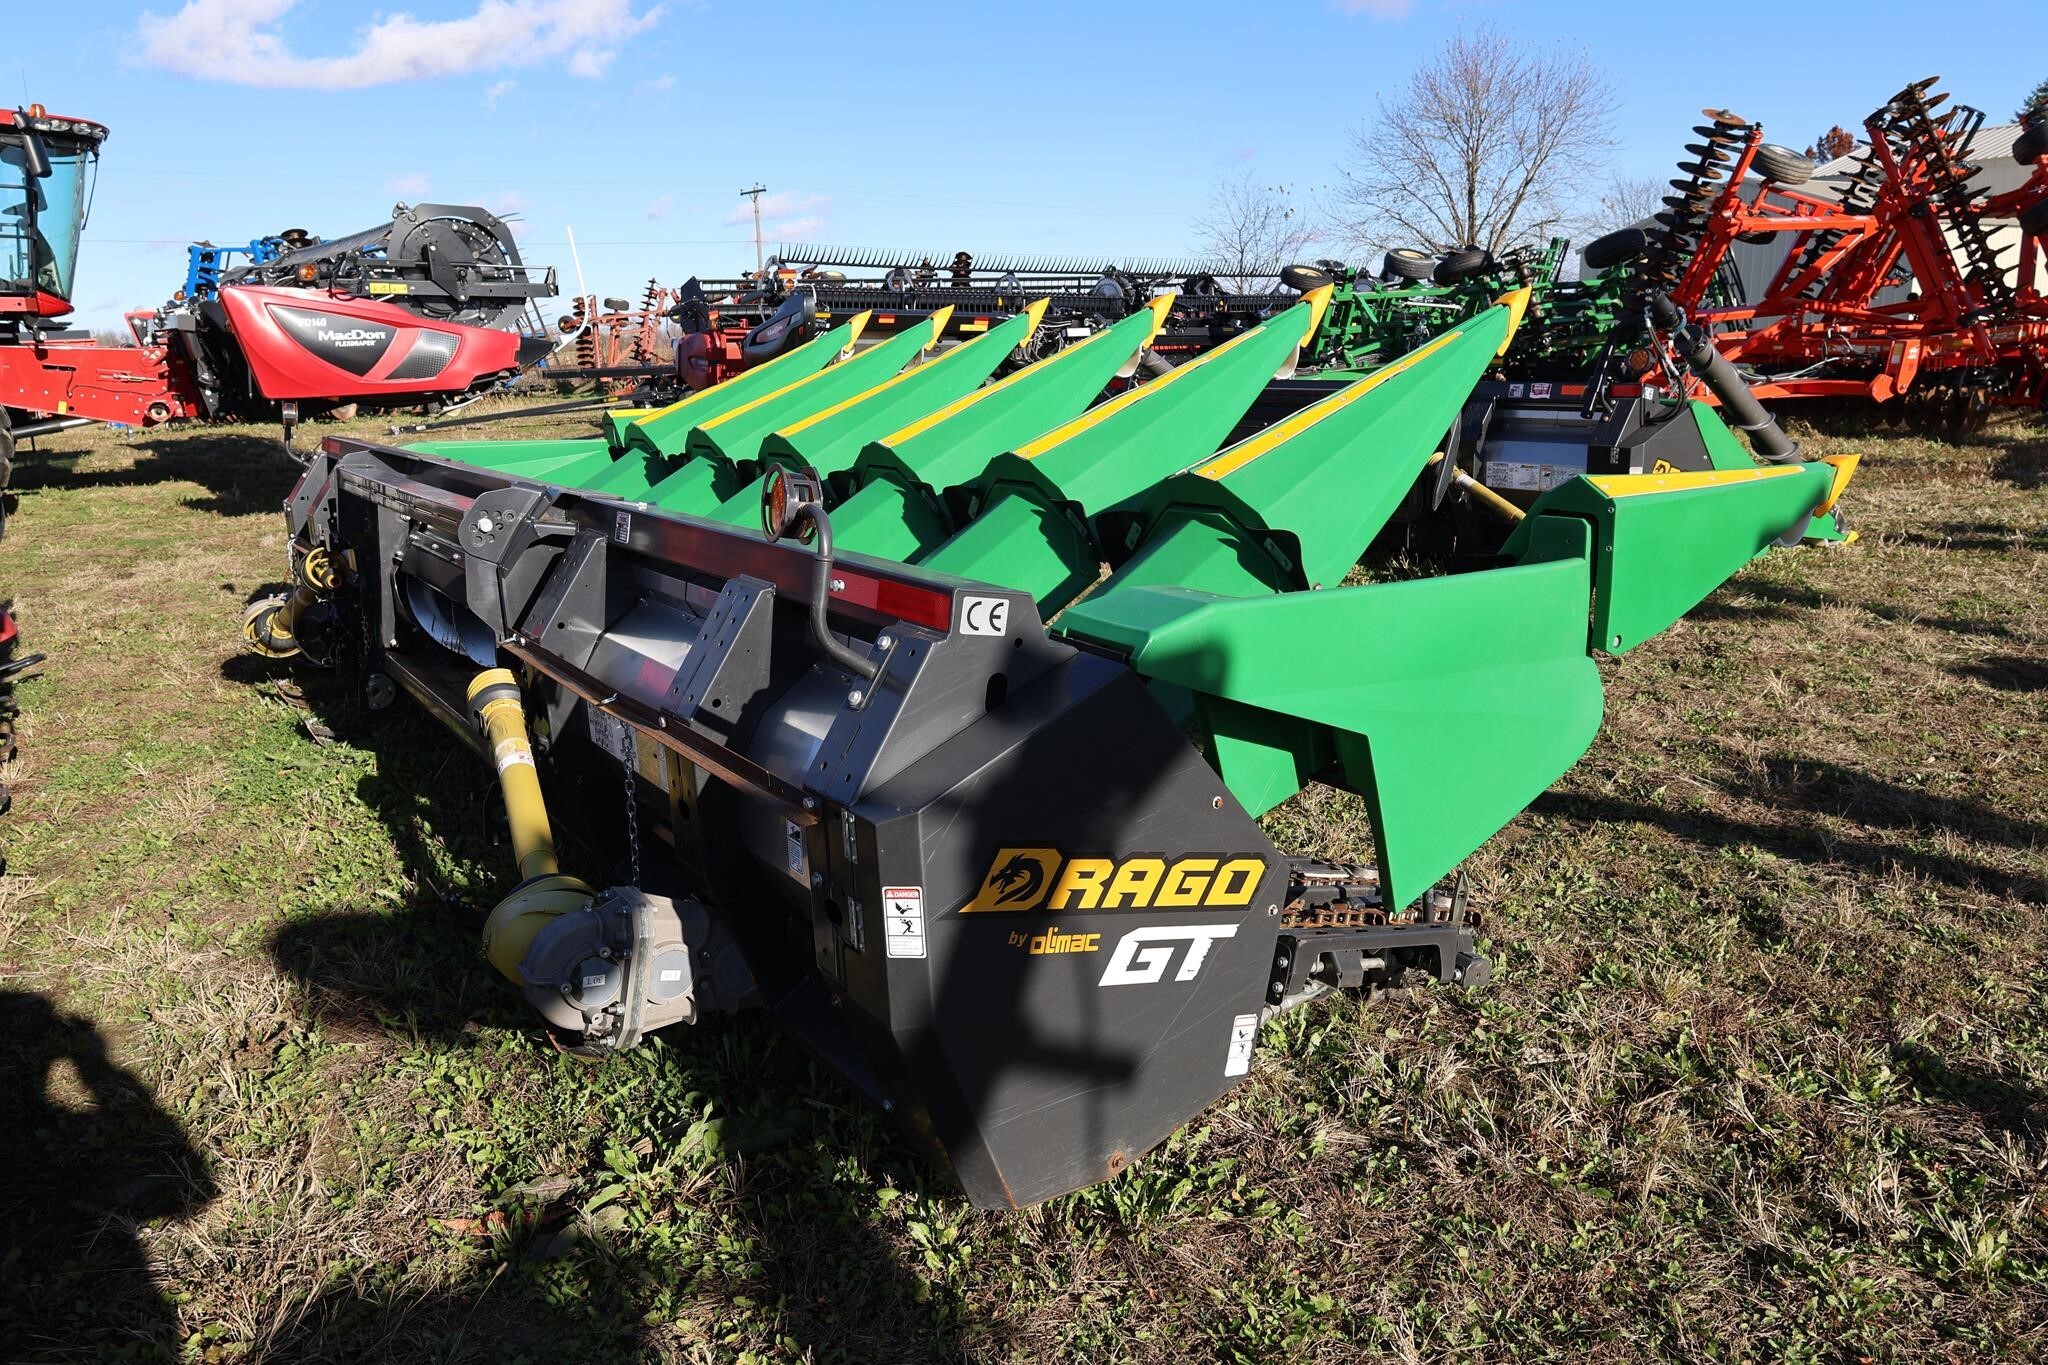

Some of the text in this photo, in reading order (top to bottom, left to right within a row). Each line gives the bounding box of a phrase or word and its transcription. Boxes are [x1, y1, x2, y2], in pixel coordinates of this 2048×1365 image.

[318, 329, 386, 341] MacDon
[958, 848, 1267, 913] DRAGO
[1008, 926, 1101, 955] by olimac
[1098, 924, 1240, 986] GT
